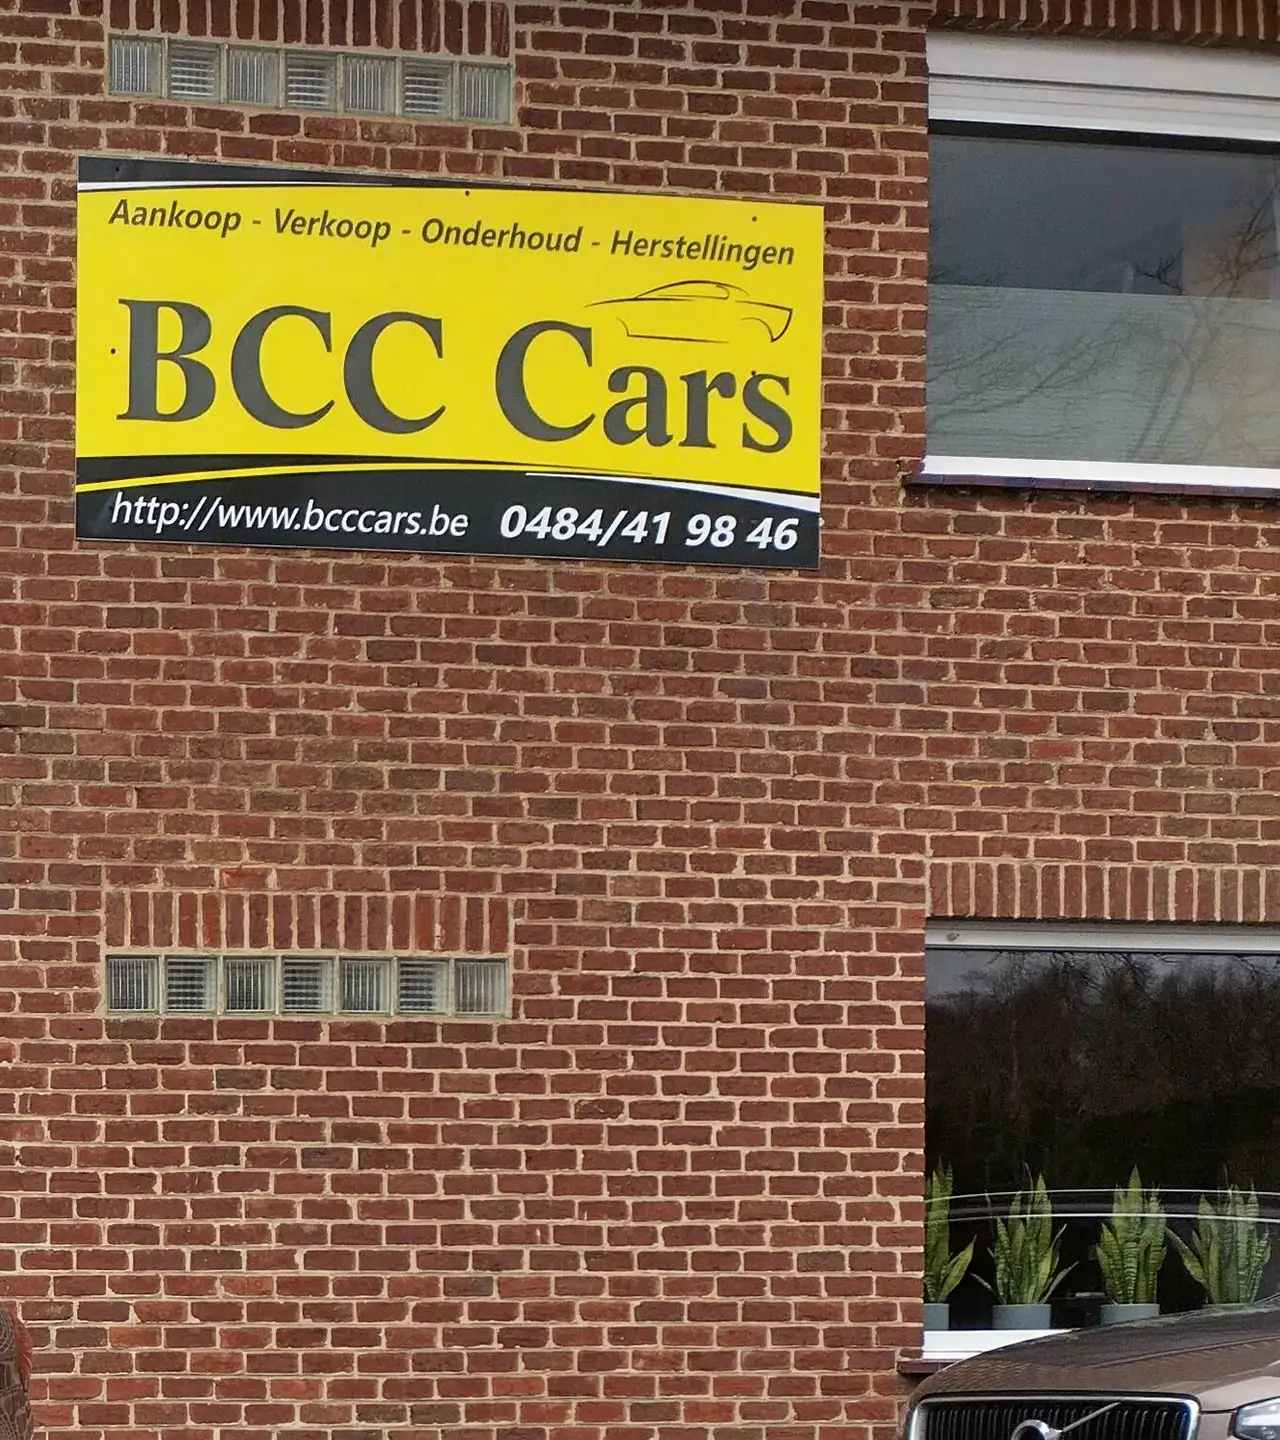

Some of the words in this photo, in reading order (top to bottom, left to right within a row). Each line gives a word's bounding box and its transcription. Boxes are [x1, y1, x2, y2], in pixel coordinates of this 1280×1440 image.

[108, 199, 242, 238] Aankoop
[274, 207, 391, 248] Verkoop
[421, 217, 583, 253] Onderhoud
[610, 229, 795, 271] Herstellingen
[115, 298, 446, 435] BCC
[495, 319, 792, 454] Cars
[111, 491, 469, 538] http://www.bcccars.be
[500, 504, 672, 547] 0484/41
[685, 513, 737, 548] 98
[746, 517, 800, 551] 46
